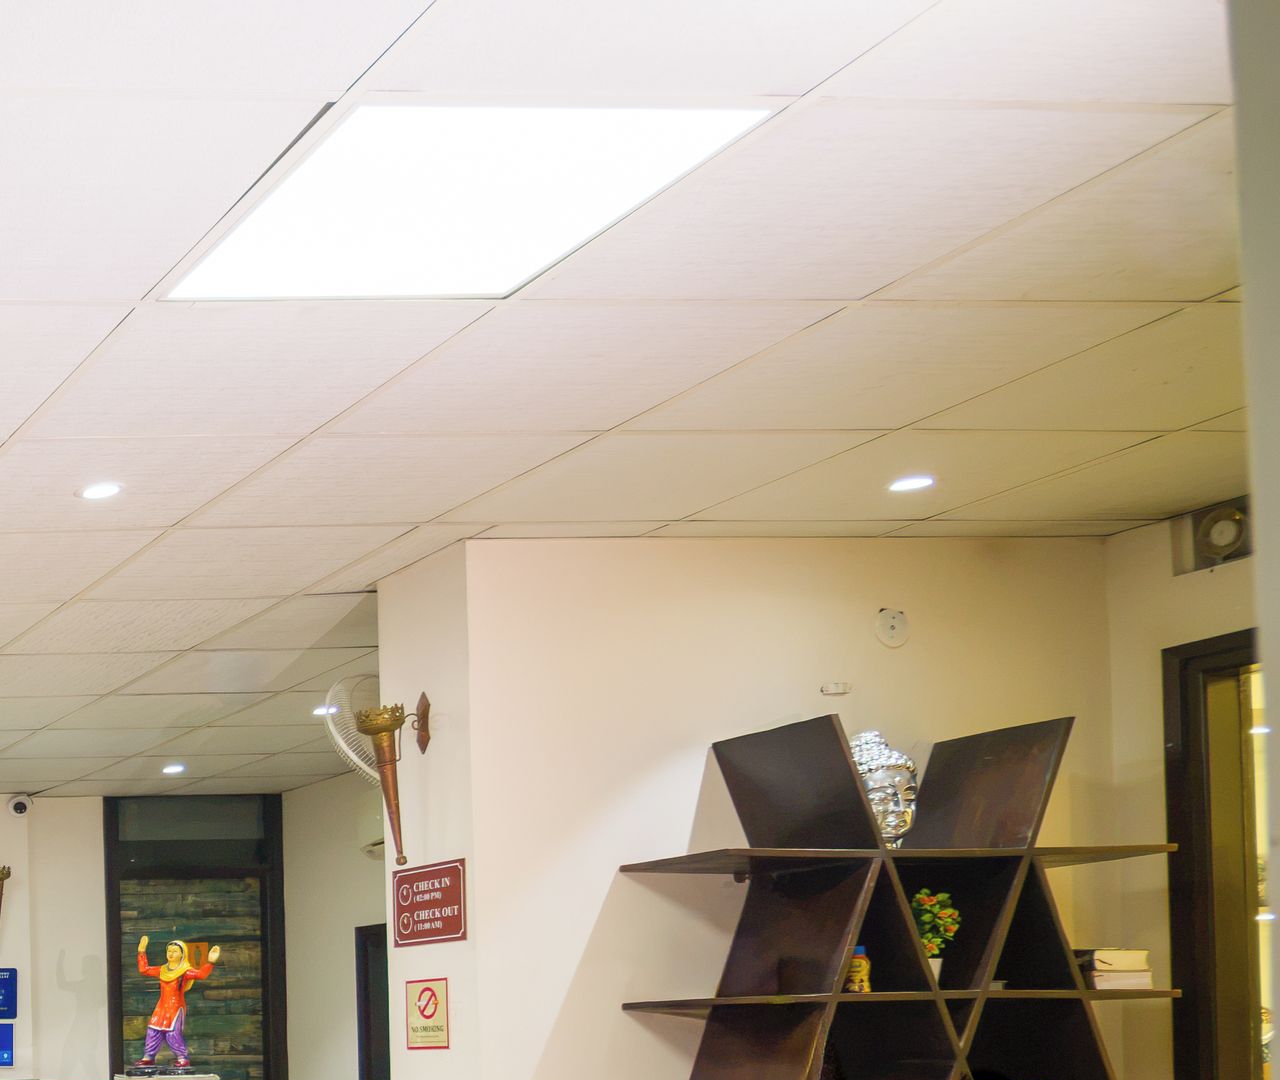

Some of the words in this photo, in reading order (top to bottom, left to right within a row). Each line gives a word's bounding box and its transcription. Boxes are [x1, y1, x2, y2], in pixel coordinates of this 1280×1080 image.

[414, 879, 440, 892] CHECK
[442, 877, 450, 888] IN
[414, 908, 441, 921] CHECK
[442, 905, 459, 917] OUT
